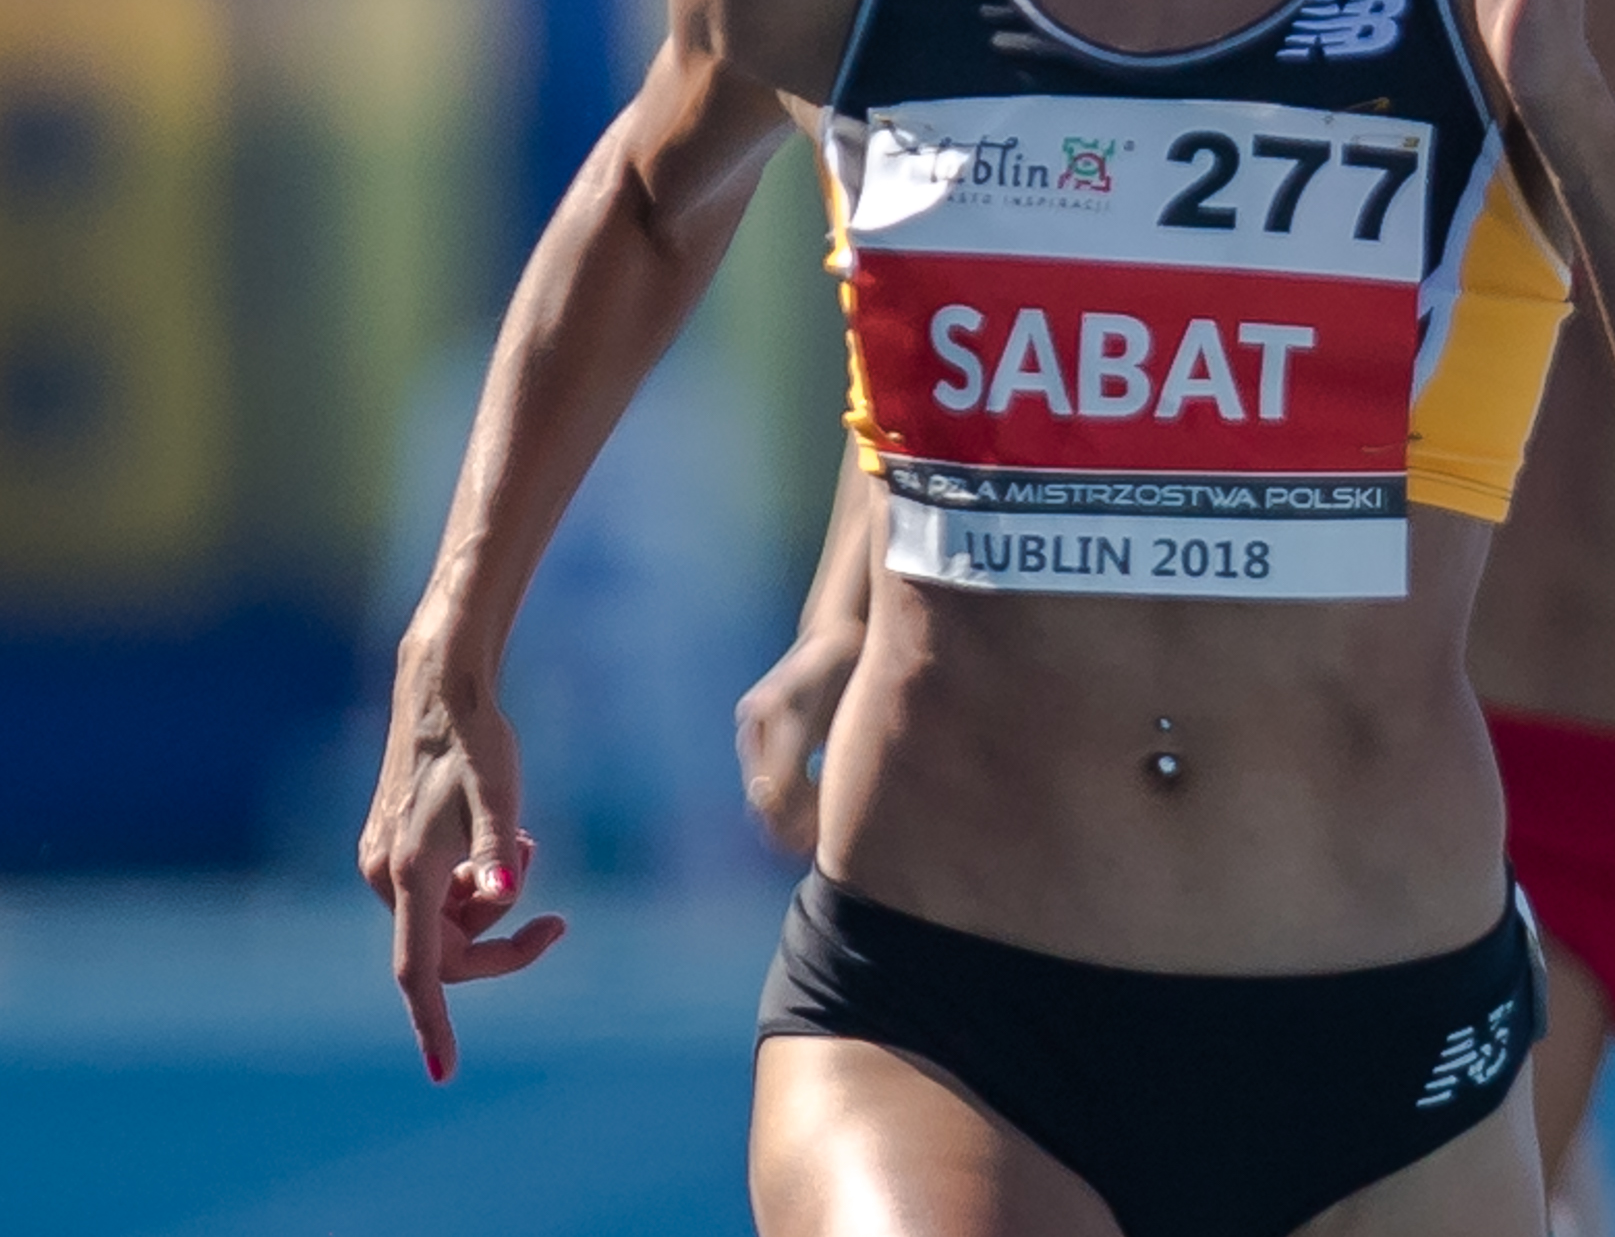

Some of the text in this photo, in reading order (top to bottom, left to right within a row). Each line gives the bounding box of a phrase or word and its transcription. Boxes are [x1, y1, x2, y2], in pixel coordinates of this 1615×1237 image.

[915, 137, 1049, 188] blin
[1156, 130, 1419, 242] 277
[929, 304, 1315, 421] SABAT
[1005, 484, 1258, 510] MISTRZOSTWA
[1265, 487, 1383, 510] POLSKI
[965, 531, 1272, 579] LUBLIN 2018
